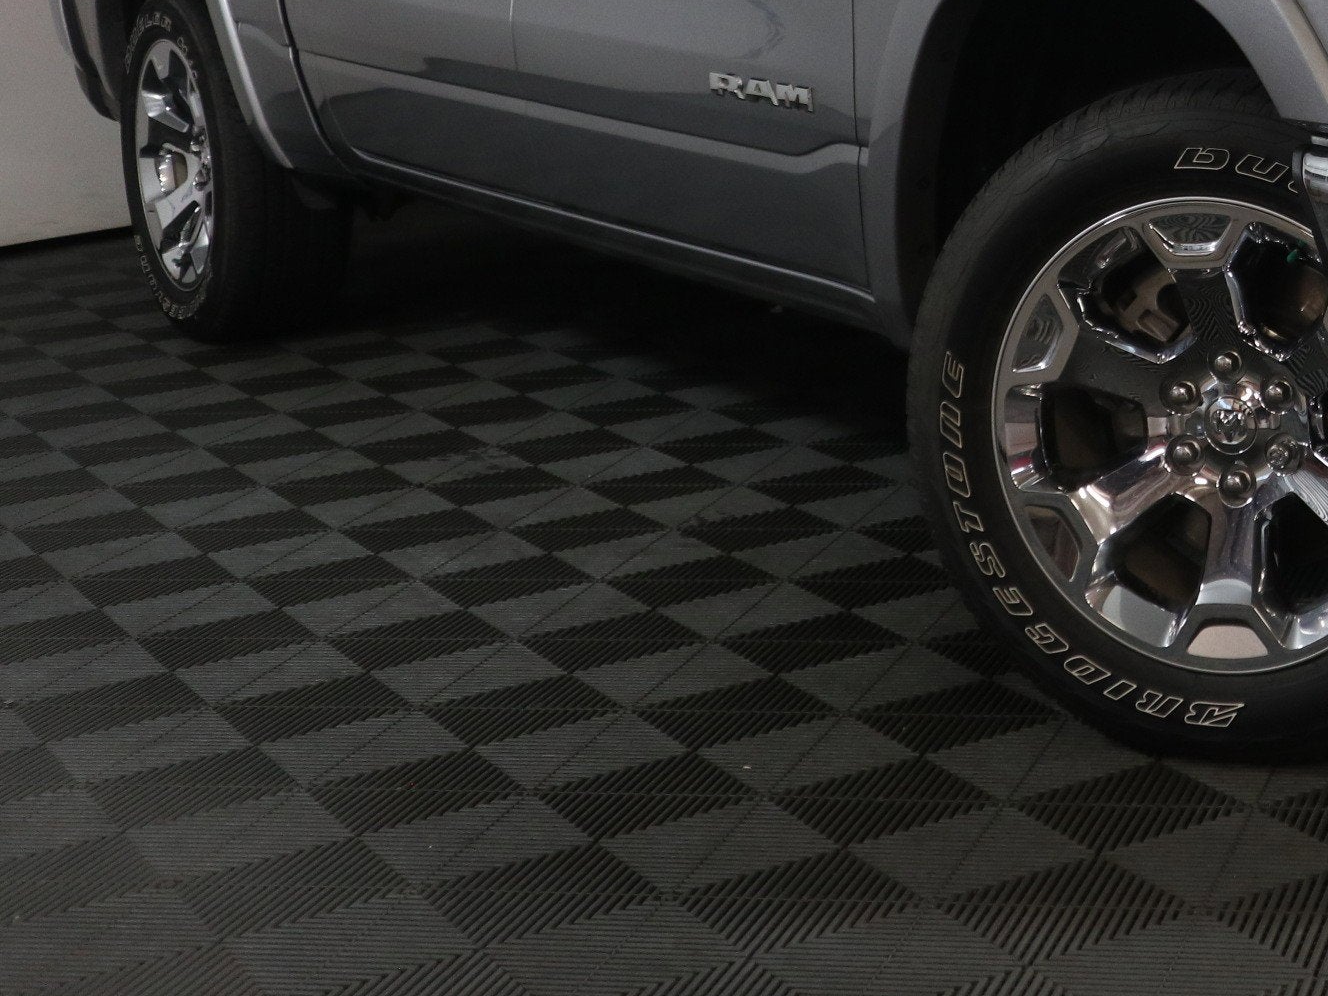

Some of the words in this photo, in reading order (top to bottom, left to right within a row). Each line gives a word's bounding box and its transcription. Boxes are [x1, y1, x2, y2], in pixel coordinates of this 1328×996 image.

[709, 71, 814, 113] RAM
[1173, 147, 1299, 194] DU
[939, 350, 1246, 728] BRIDGESTONE
